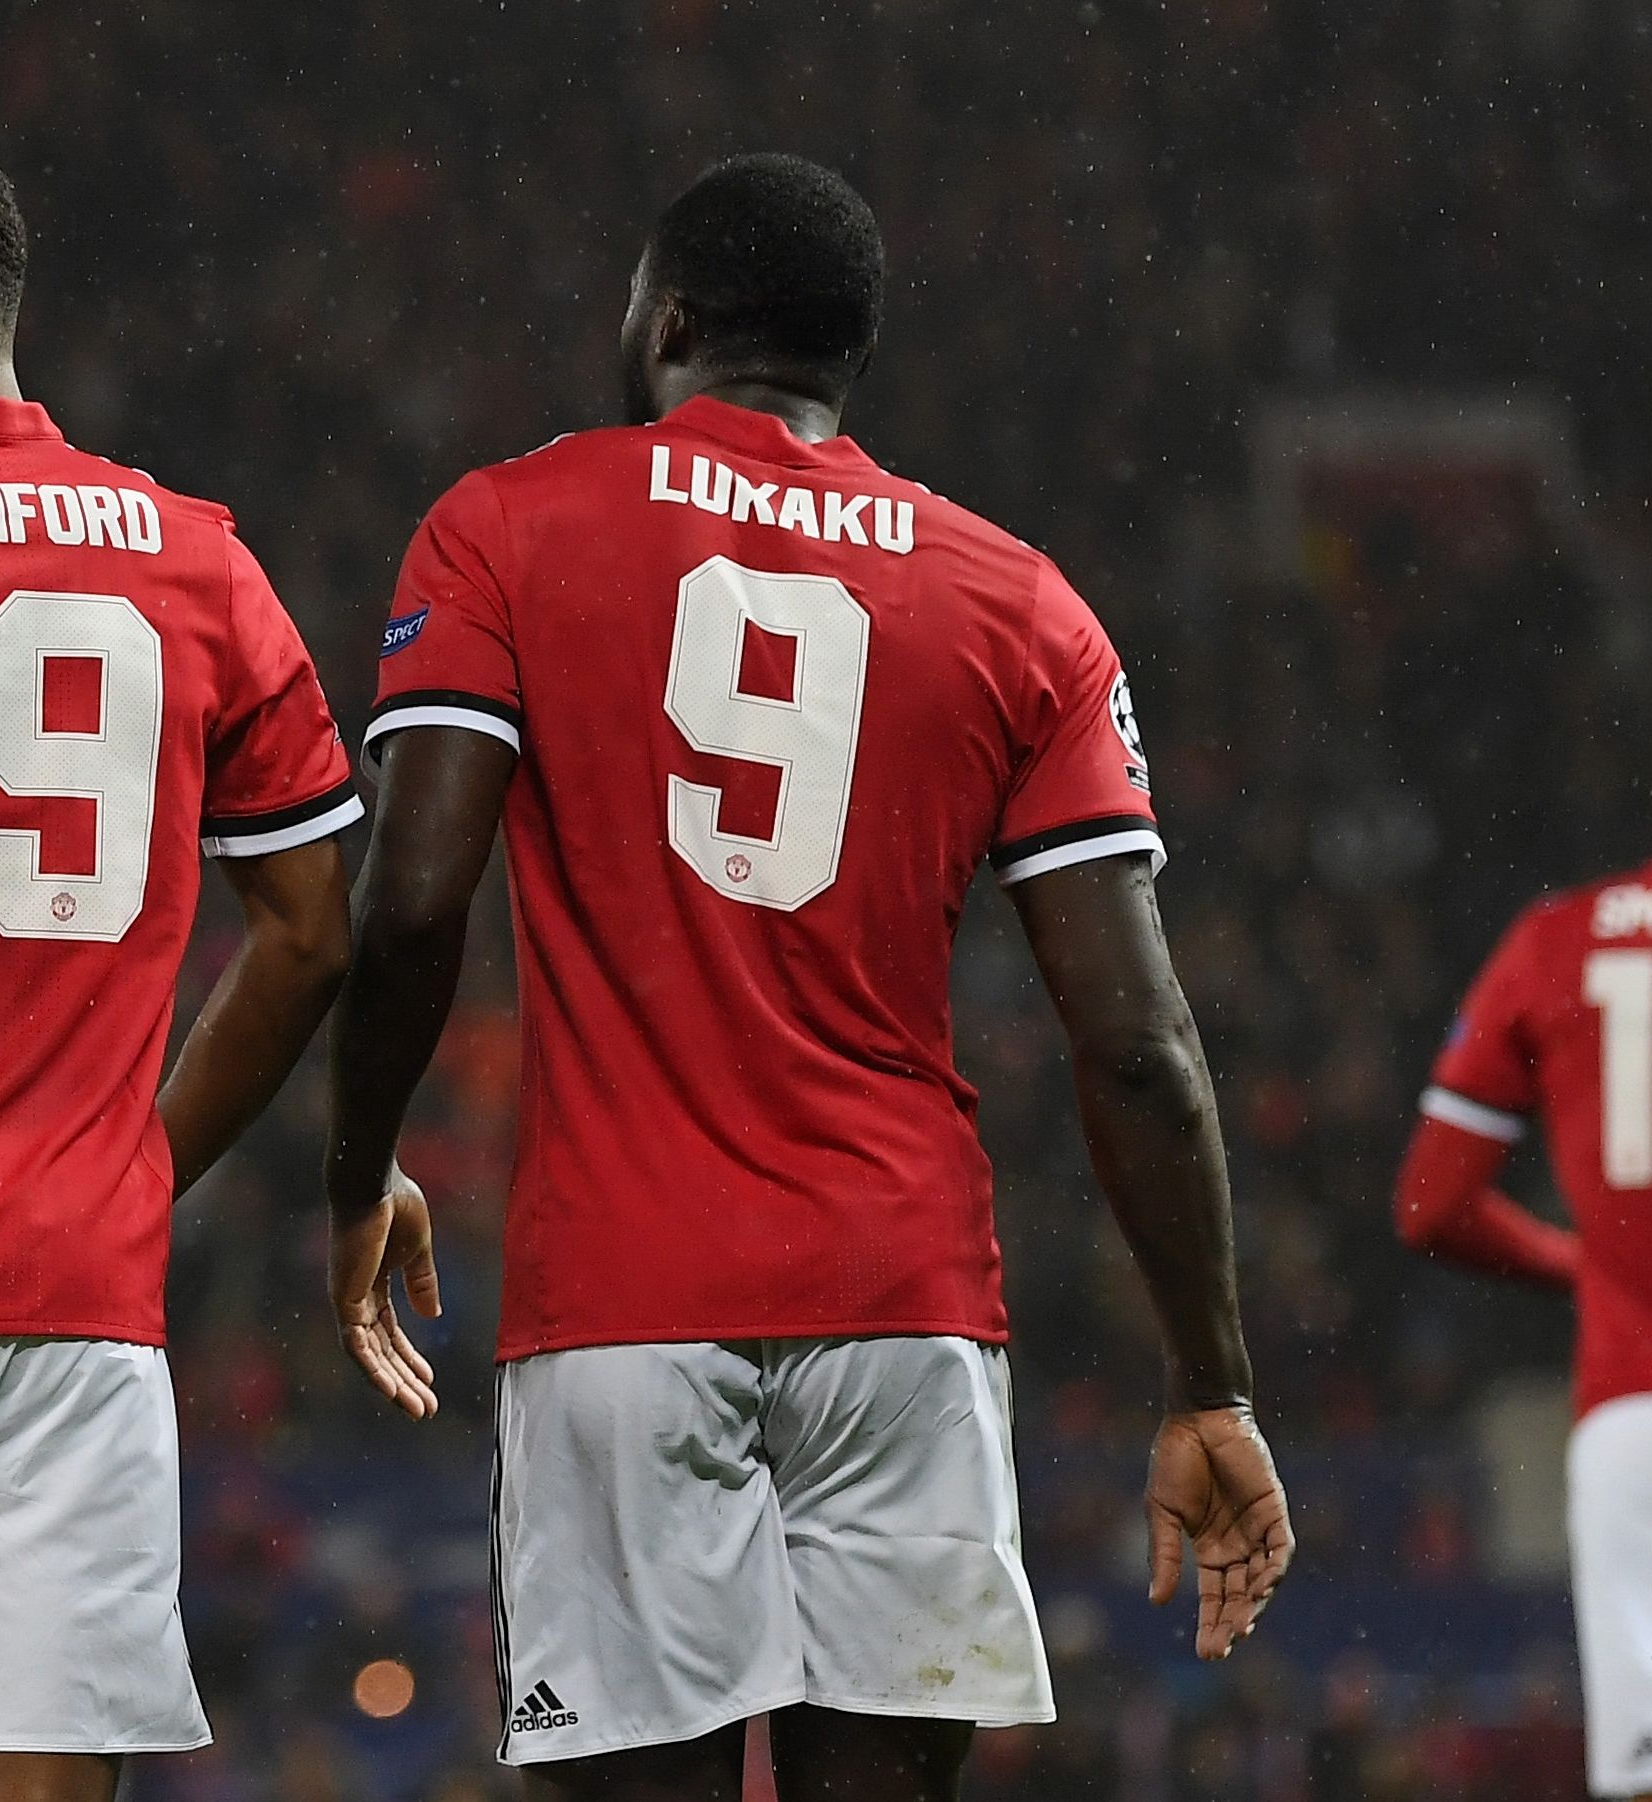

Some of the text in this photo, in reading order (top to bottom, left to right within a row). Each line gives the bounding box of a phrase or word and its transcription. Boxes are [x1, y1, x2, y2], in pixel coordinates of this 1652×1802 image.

[649, 444, 915, 555] LUKAKU
[663, 554, 871, 913] 9
[511, 1709, 579, 1733] adidas
